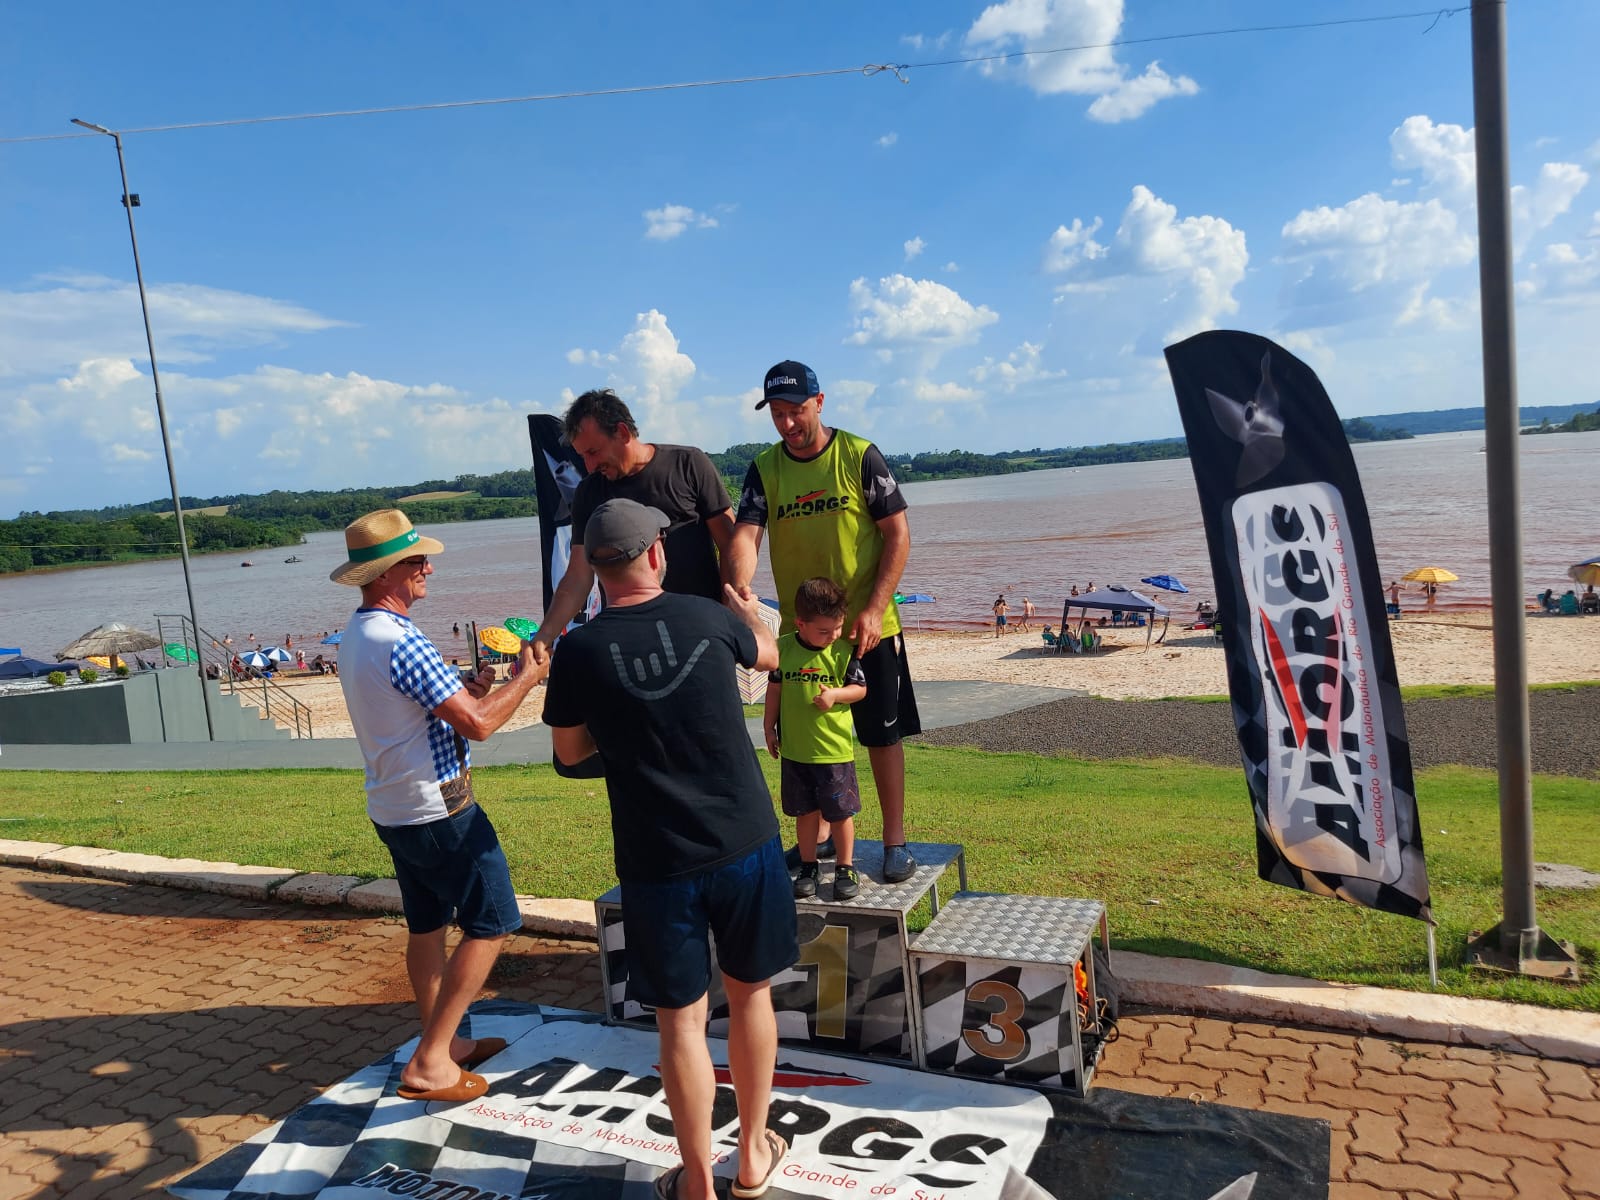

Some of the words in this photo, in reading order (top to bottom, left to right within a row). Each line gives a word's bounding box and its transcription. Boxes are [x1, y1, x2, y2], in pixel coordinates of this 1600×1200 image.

[777, 495, 850, 520] AMORGS
[1326, 513, 1340, 532] Sul
[1331, 538, 1345, 556] do
[1337, 562, 1355, 610] Grande
[1348, 617, 1359, 636] Rio
[1351, 644, 1363, 661] do
[1271, 503, 1371, 864] AMORGS
[1367, 753, 1378, 770] de
[1370, 778, 1386, 848] Associação
[795, 925, 849, 1039] 1
[963, 980, 1026, 1060] 3
[467, 1103, 553, 1128] Associação
[560, 1121, 584, 1135] de
[592, 1127, 681, 1156] Motonáutic
[782, 1163, 857, 1189] Grande
[870, 1182, 897, 1195] do
